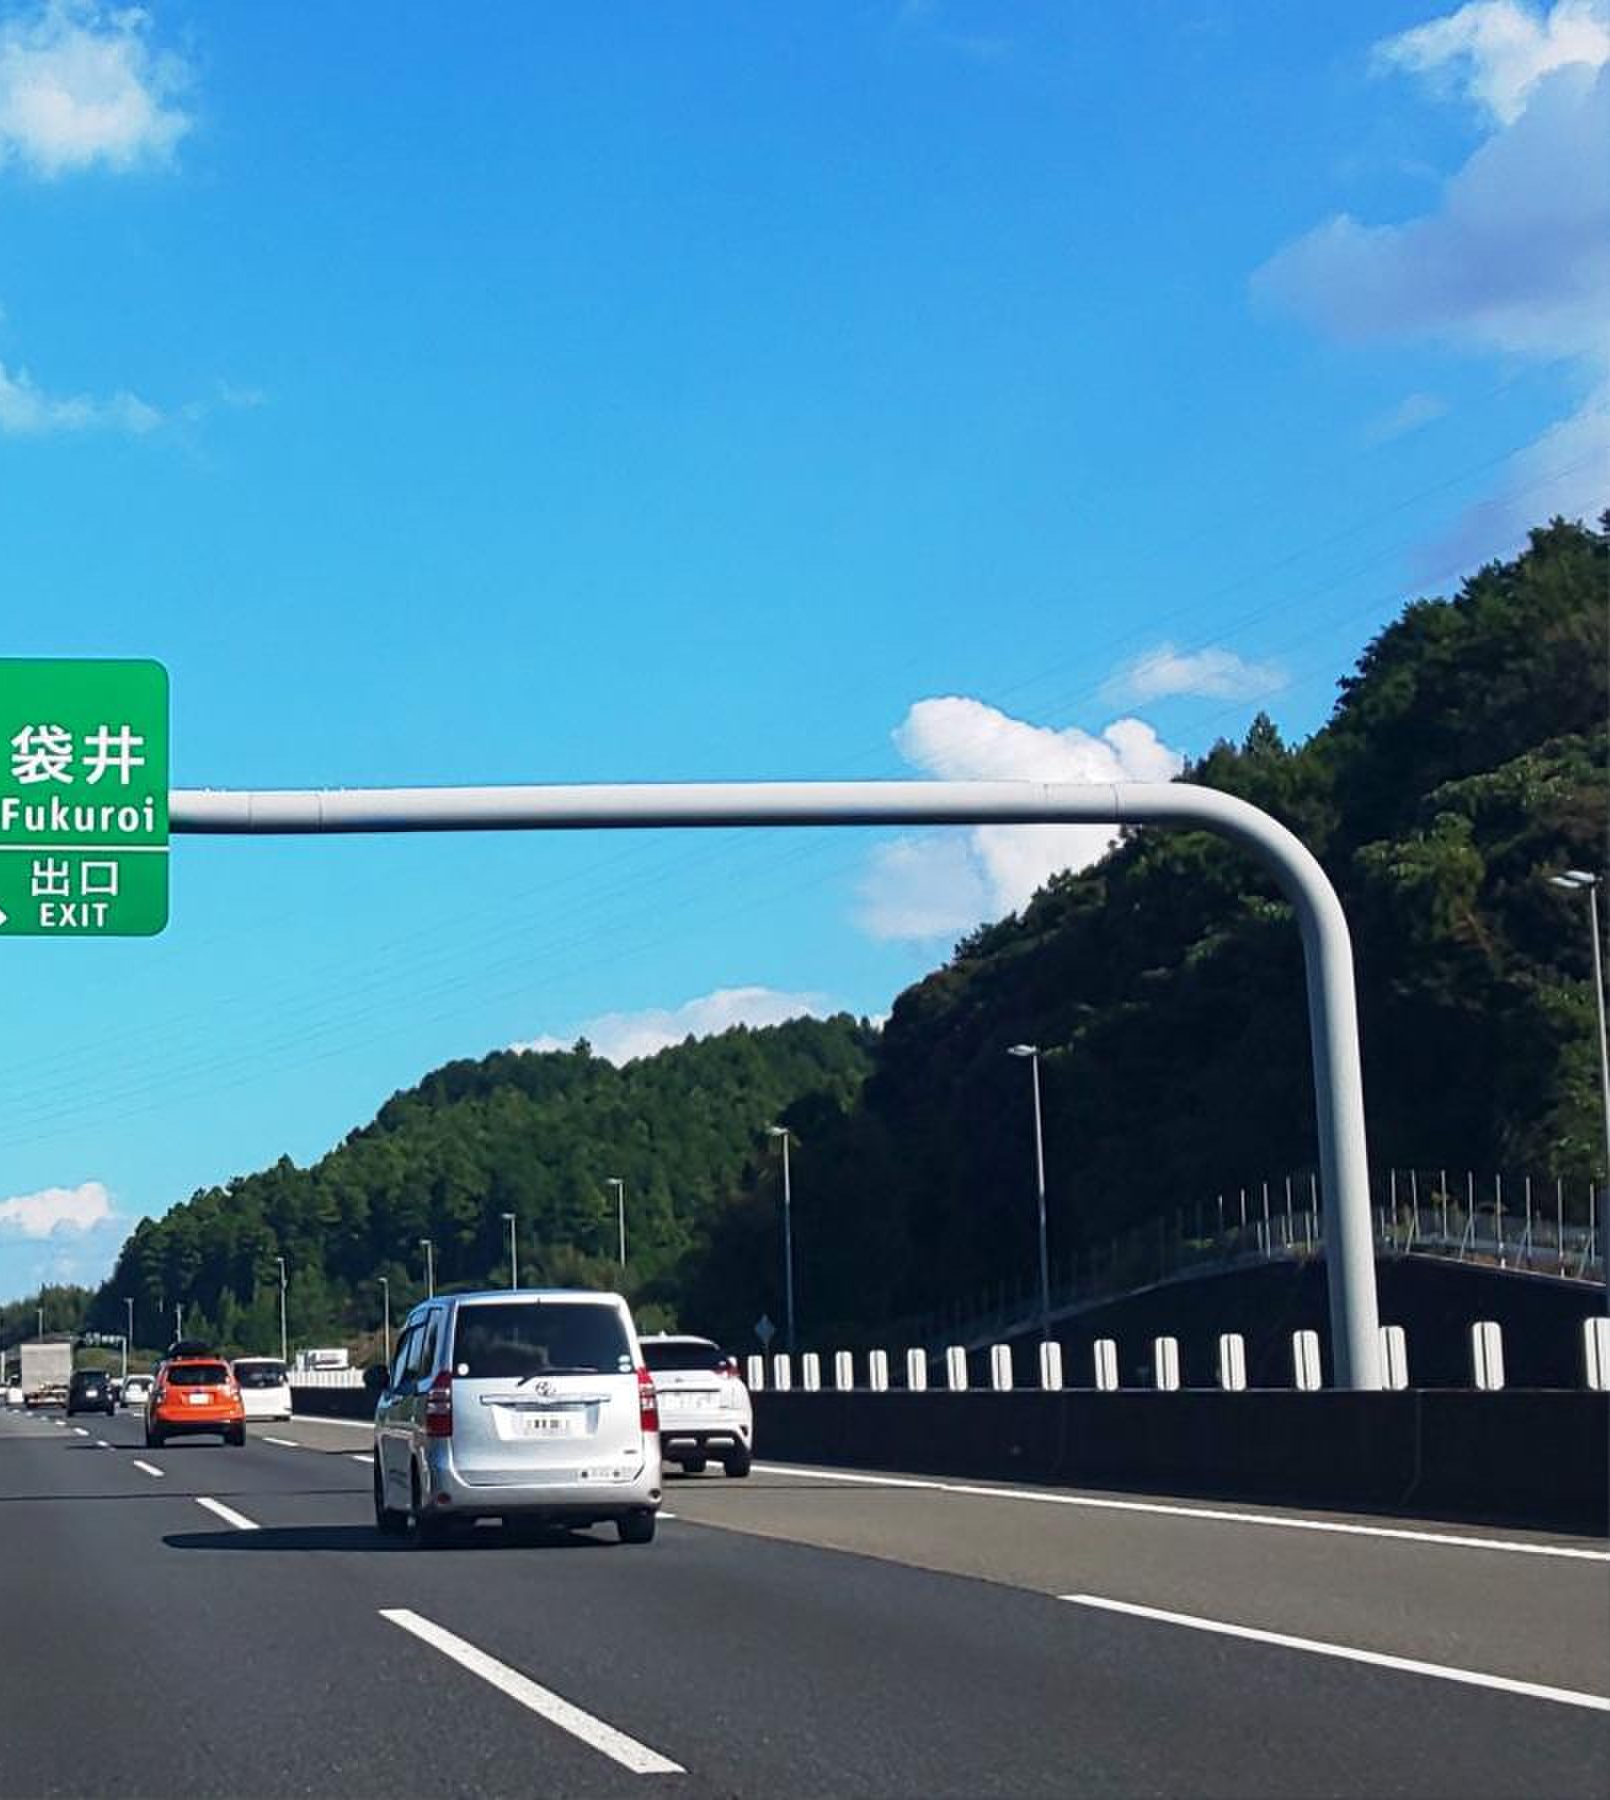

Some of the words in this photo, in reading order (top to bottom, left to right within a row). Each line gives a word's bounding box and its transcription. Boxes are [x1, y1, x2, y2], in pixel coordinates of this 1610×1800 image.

[11, 724, 145, 785] 袋井
[1, 796, 154, 832] Fukuroi
[31, 858, 119, 897] 出口
[39, 903, 108, 928] EXIT
